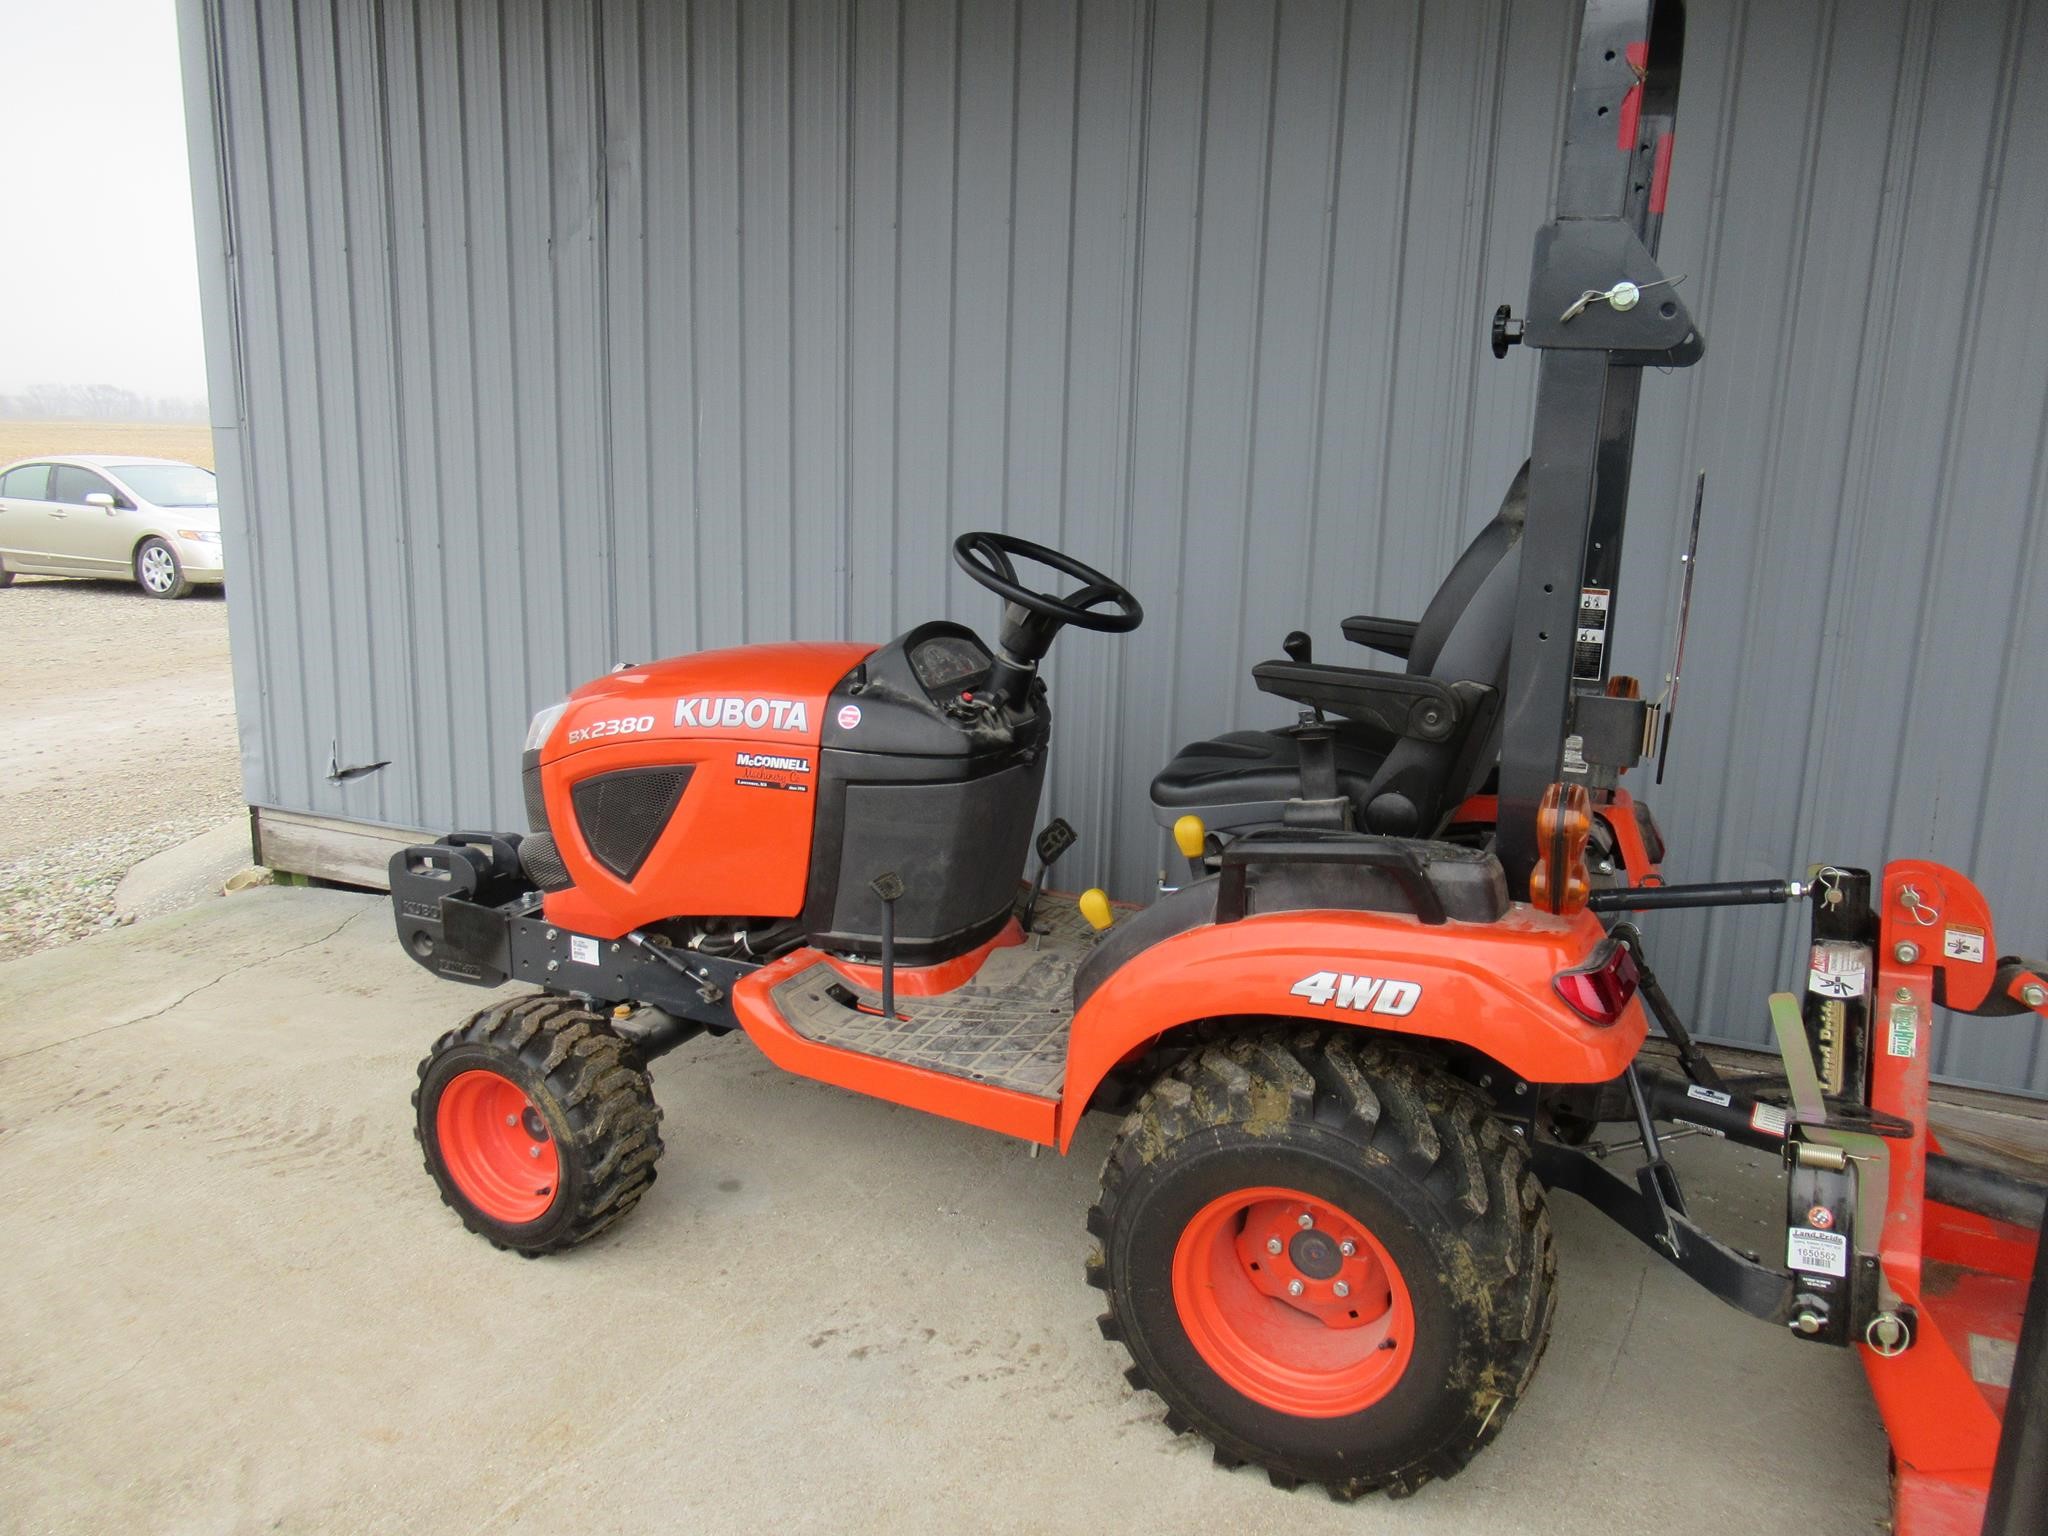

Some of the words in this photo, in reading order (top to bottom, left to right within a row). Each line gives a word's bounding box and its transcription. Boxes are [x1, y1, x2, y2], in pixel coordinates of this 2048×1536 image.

[673, 698, 808, 733] KUBOTA
[568, 716, 655, 744] BX2380
[1290, 971, 1423, 1017] 4WD
[1793, 1229, 1815, 1239] Land
[1797, 1248, 1837, 1261] 1650562
